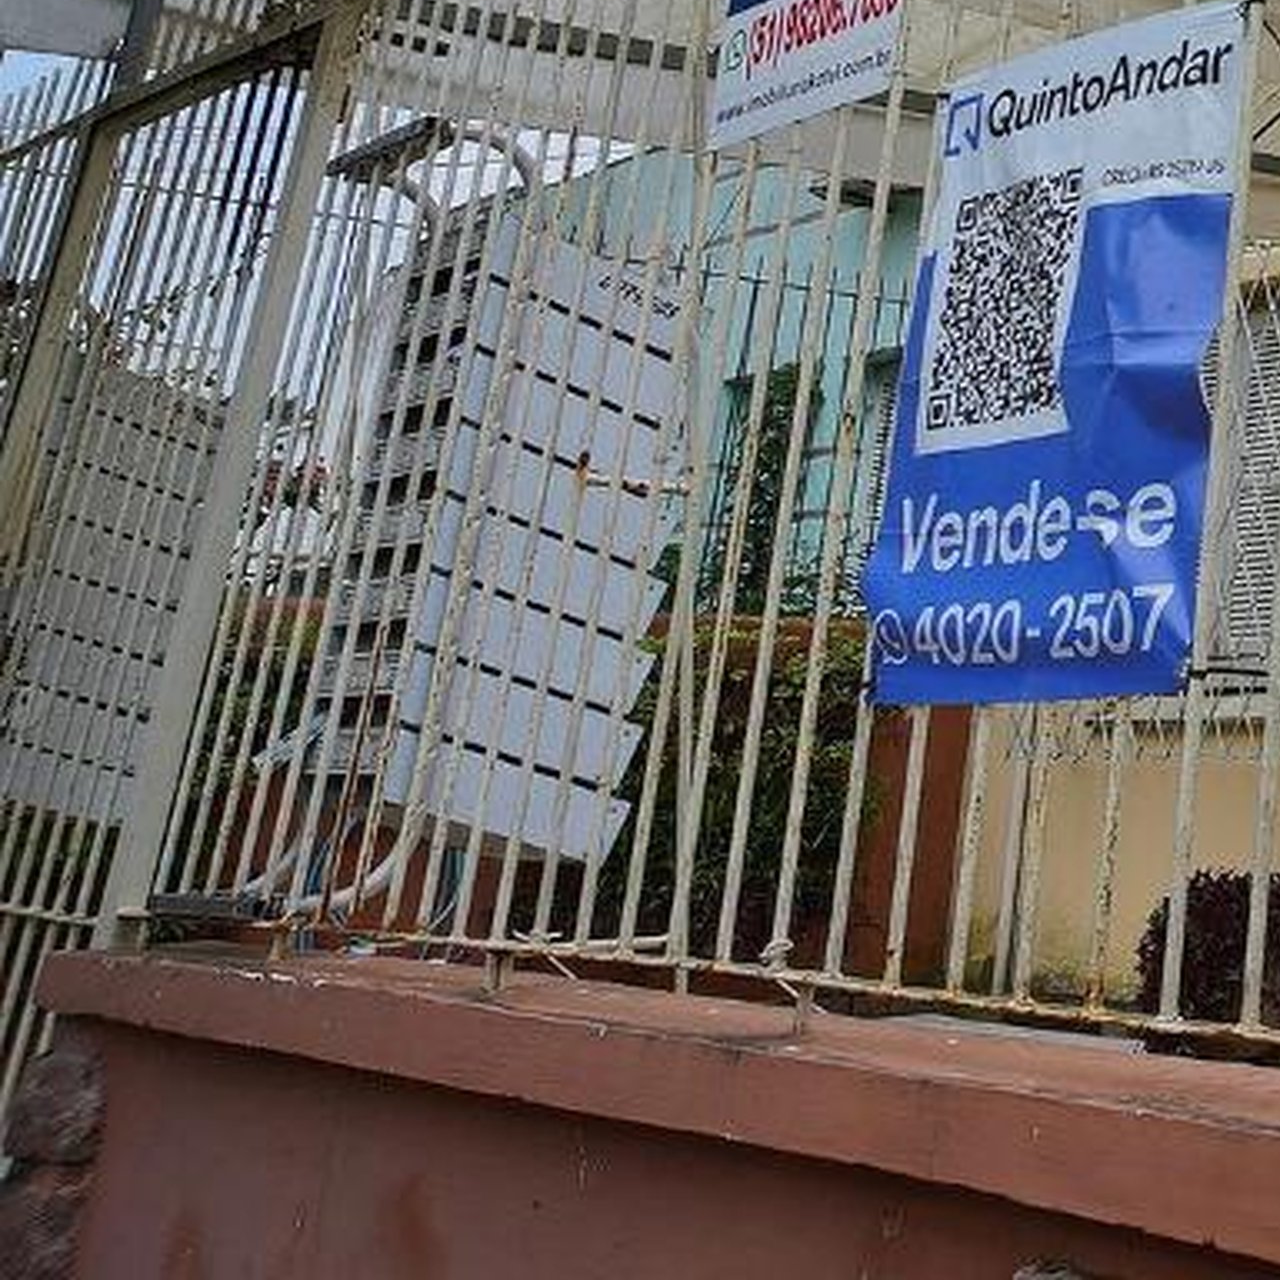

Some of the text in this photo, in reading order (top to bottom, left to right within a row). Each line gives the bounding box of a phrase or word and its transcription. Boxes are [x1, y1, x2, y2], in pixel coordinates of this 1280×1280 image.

[987, 40, 1233, 138] QuintoAndar
[901, 478, 1177, 574] Vende-se
[913, 582, 1175, 665] 4020-2507
